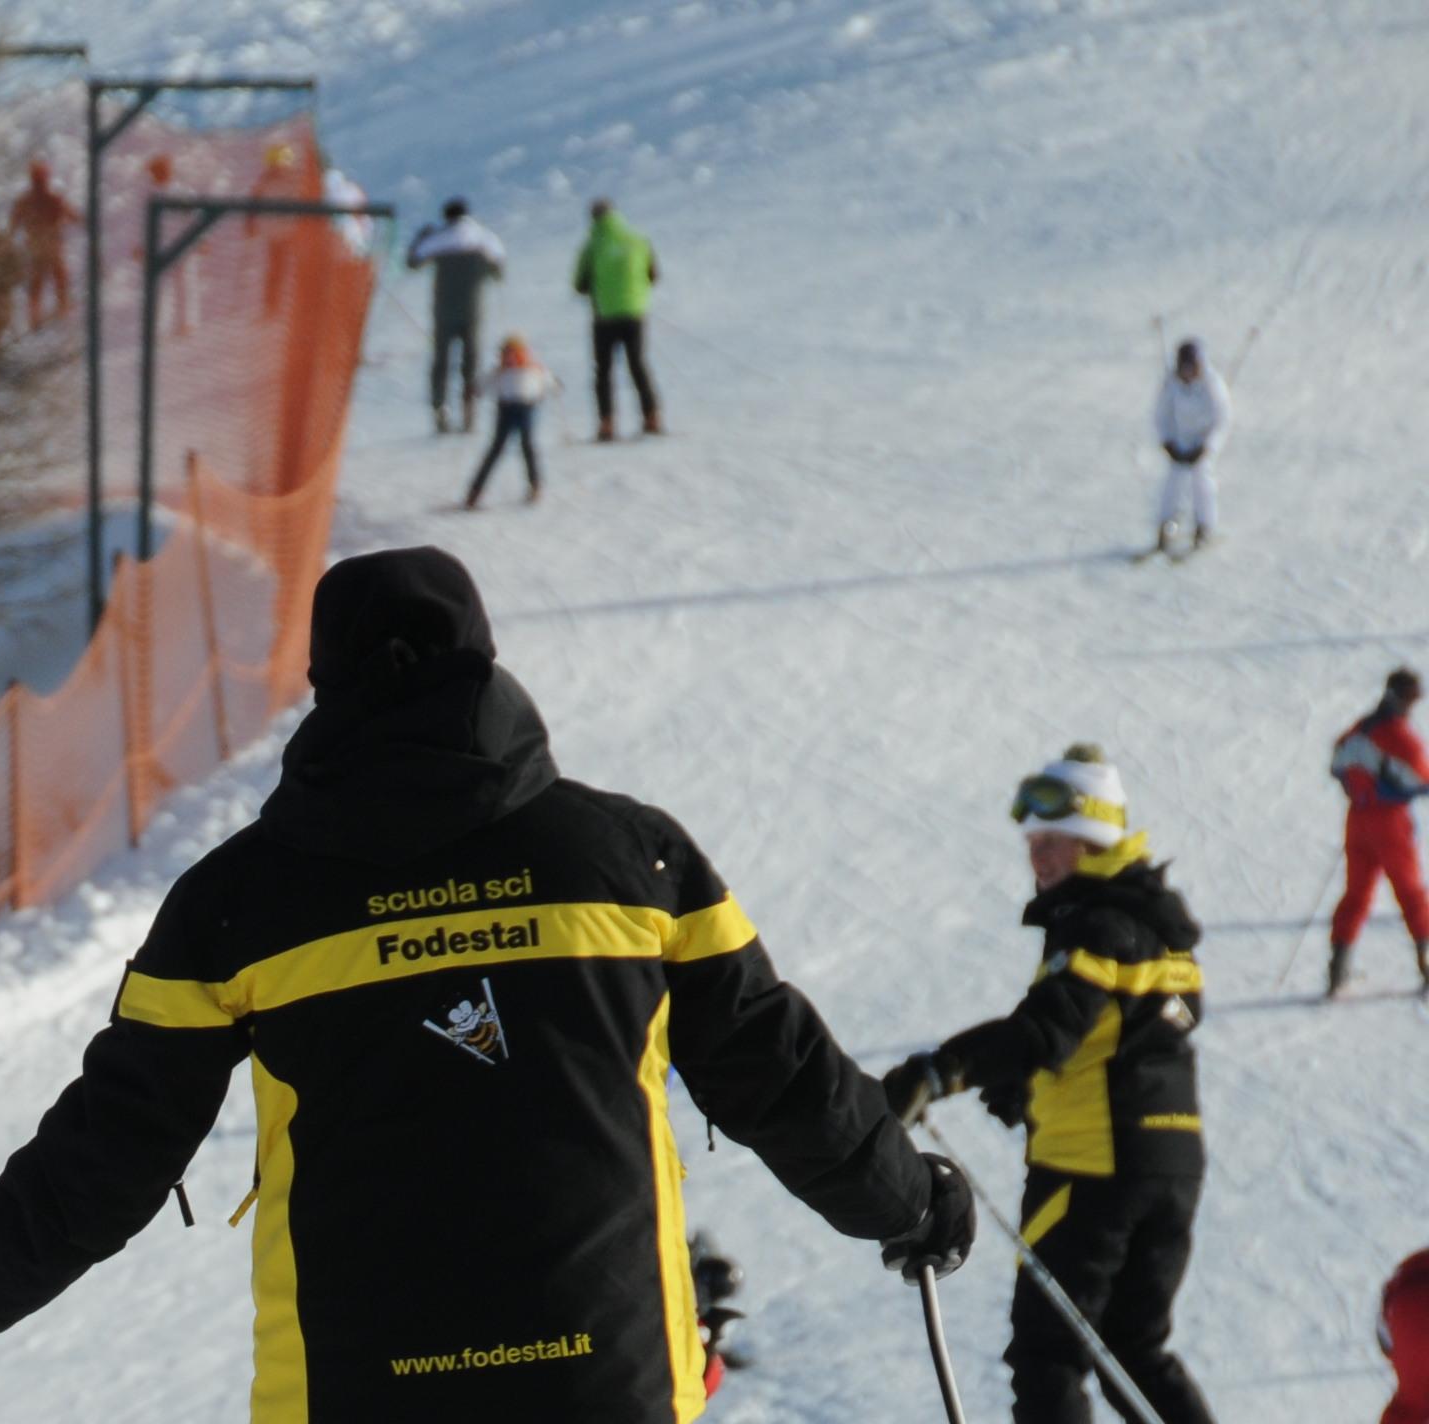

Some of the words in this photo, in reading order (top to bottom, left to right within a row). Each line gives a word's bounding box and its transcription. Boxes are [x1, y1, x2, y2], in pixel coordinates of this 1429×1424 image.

[367, 879, 479, 915] scuola
[484, 868, 533, 899] sci
[376, 918, 540, 965] Fodestal
[390, 1333, 594, 1375] www.fodestal.it
